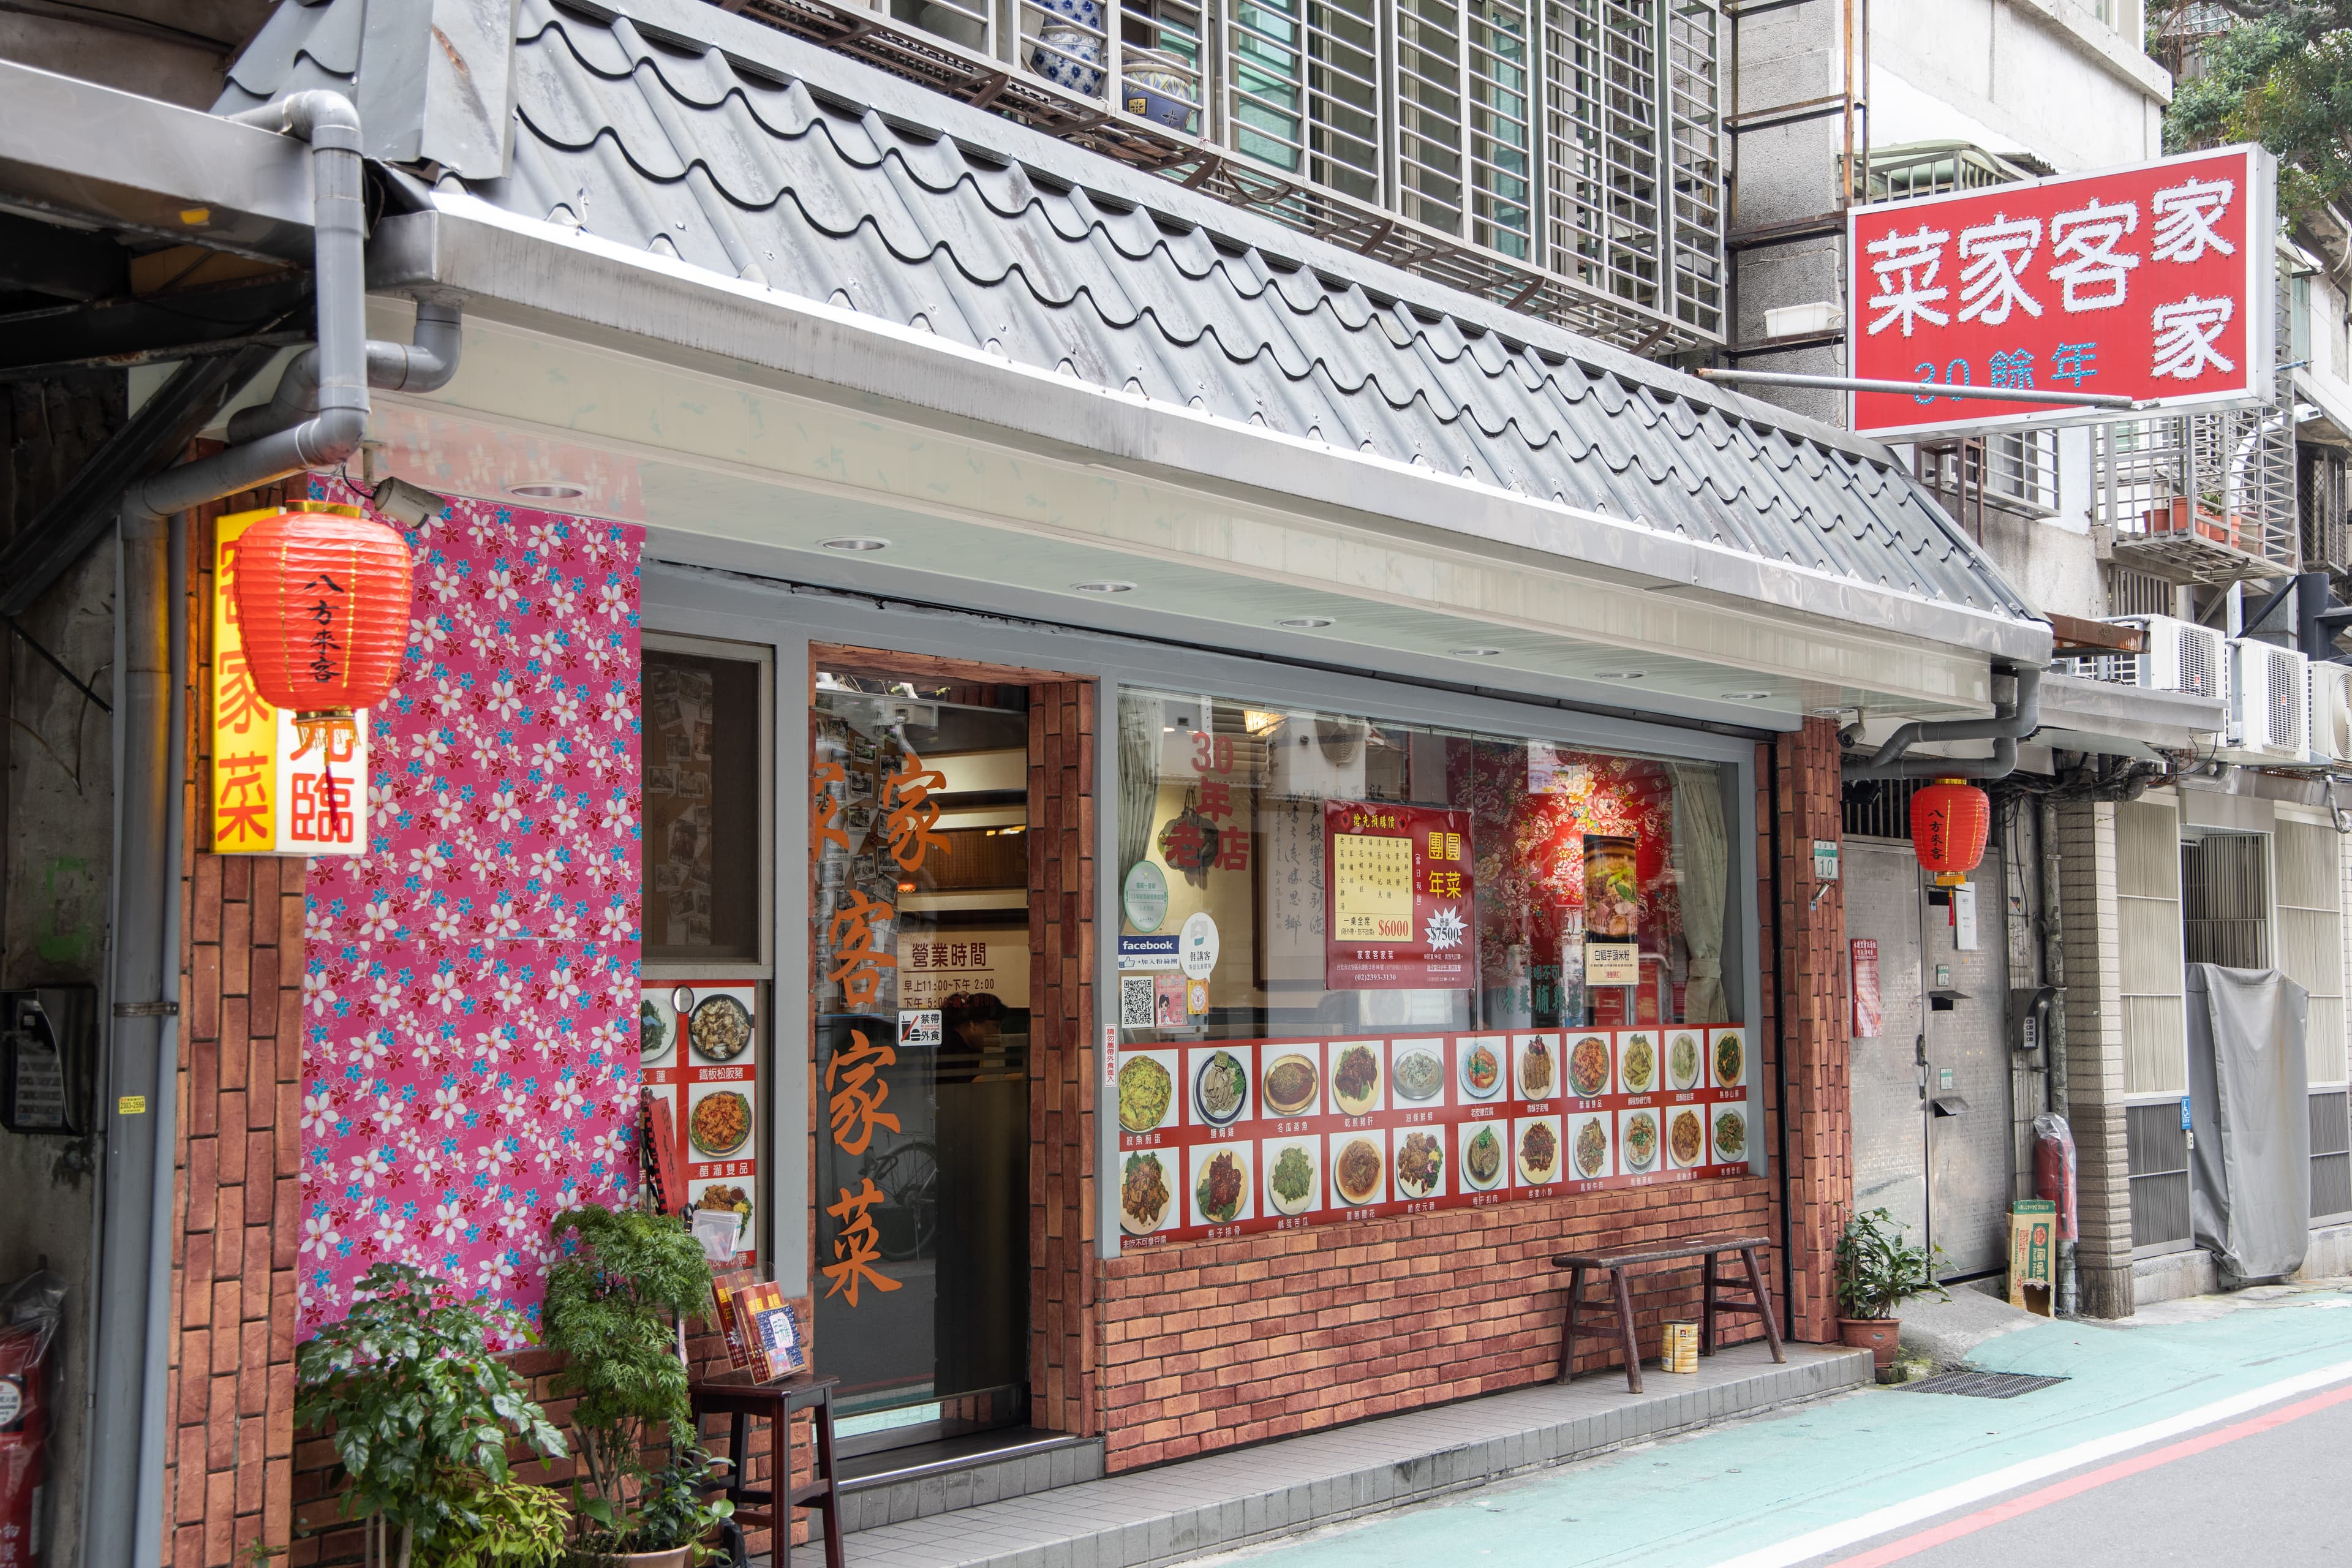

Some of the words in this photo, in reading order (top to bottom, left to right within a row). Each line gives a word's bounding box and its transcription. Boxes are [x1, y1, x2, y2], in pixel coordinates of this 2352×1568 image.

[304, 574, 344, 683] 八方來客
[217, 540, 270, 843] 家菜
[1191, 731, 1234, 775] 30
[1196, 776, 1234, 823] 年
[1353, 813, 1396, 829] 搶先預購價
[1928, 809, 1945, 860] 八方來客
[1165, 821, 1250, 871] 老店
[1820, 858, 1833, 876] 10
[1428, 870, 1462, 900] 年菜
[1378, 919, 1409, 937] $6000
[1430, 926, 1459, 941] $7500
[1122, 940, 1173, 950] facebook
[912, 943, 986, 968] 營業時間
[1357, 950, 1394, 960] 家家客家菜
[974, 979, 994, 990] 2:00
[903, 996, 923, 1009] 下午
[921, 1014, 940, 1024] 禁帶
[921, 1030, 940, 1041] 外食
[698, 1067, 744, 1080] 鐵板松阪豬
[822, 888, 903, 1308] 客家菜
[1277, 1121, 1308, 1133] 冬瓜蒸魚
[1344, 1116, 1374, 1128] 乾煎豬肝
[699, 1162, 748, 1178] 醋溜雙品
